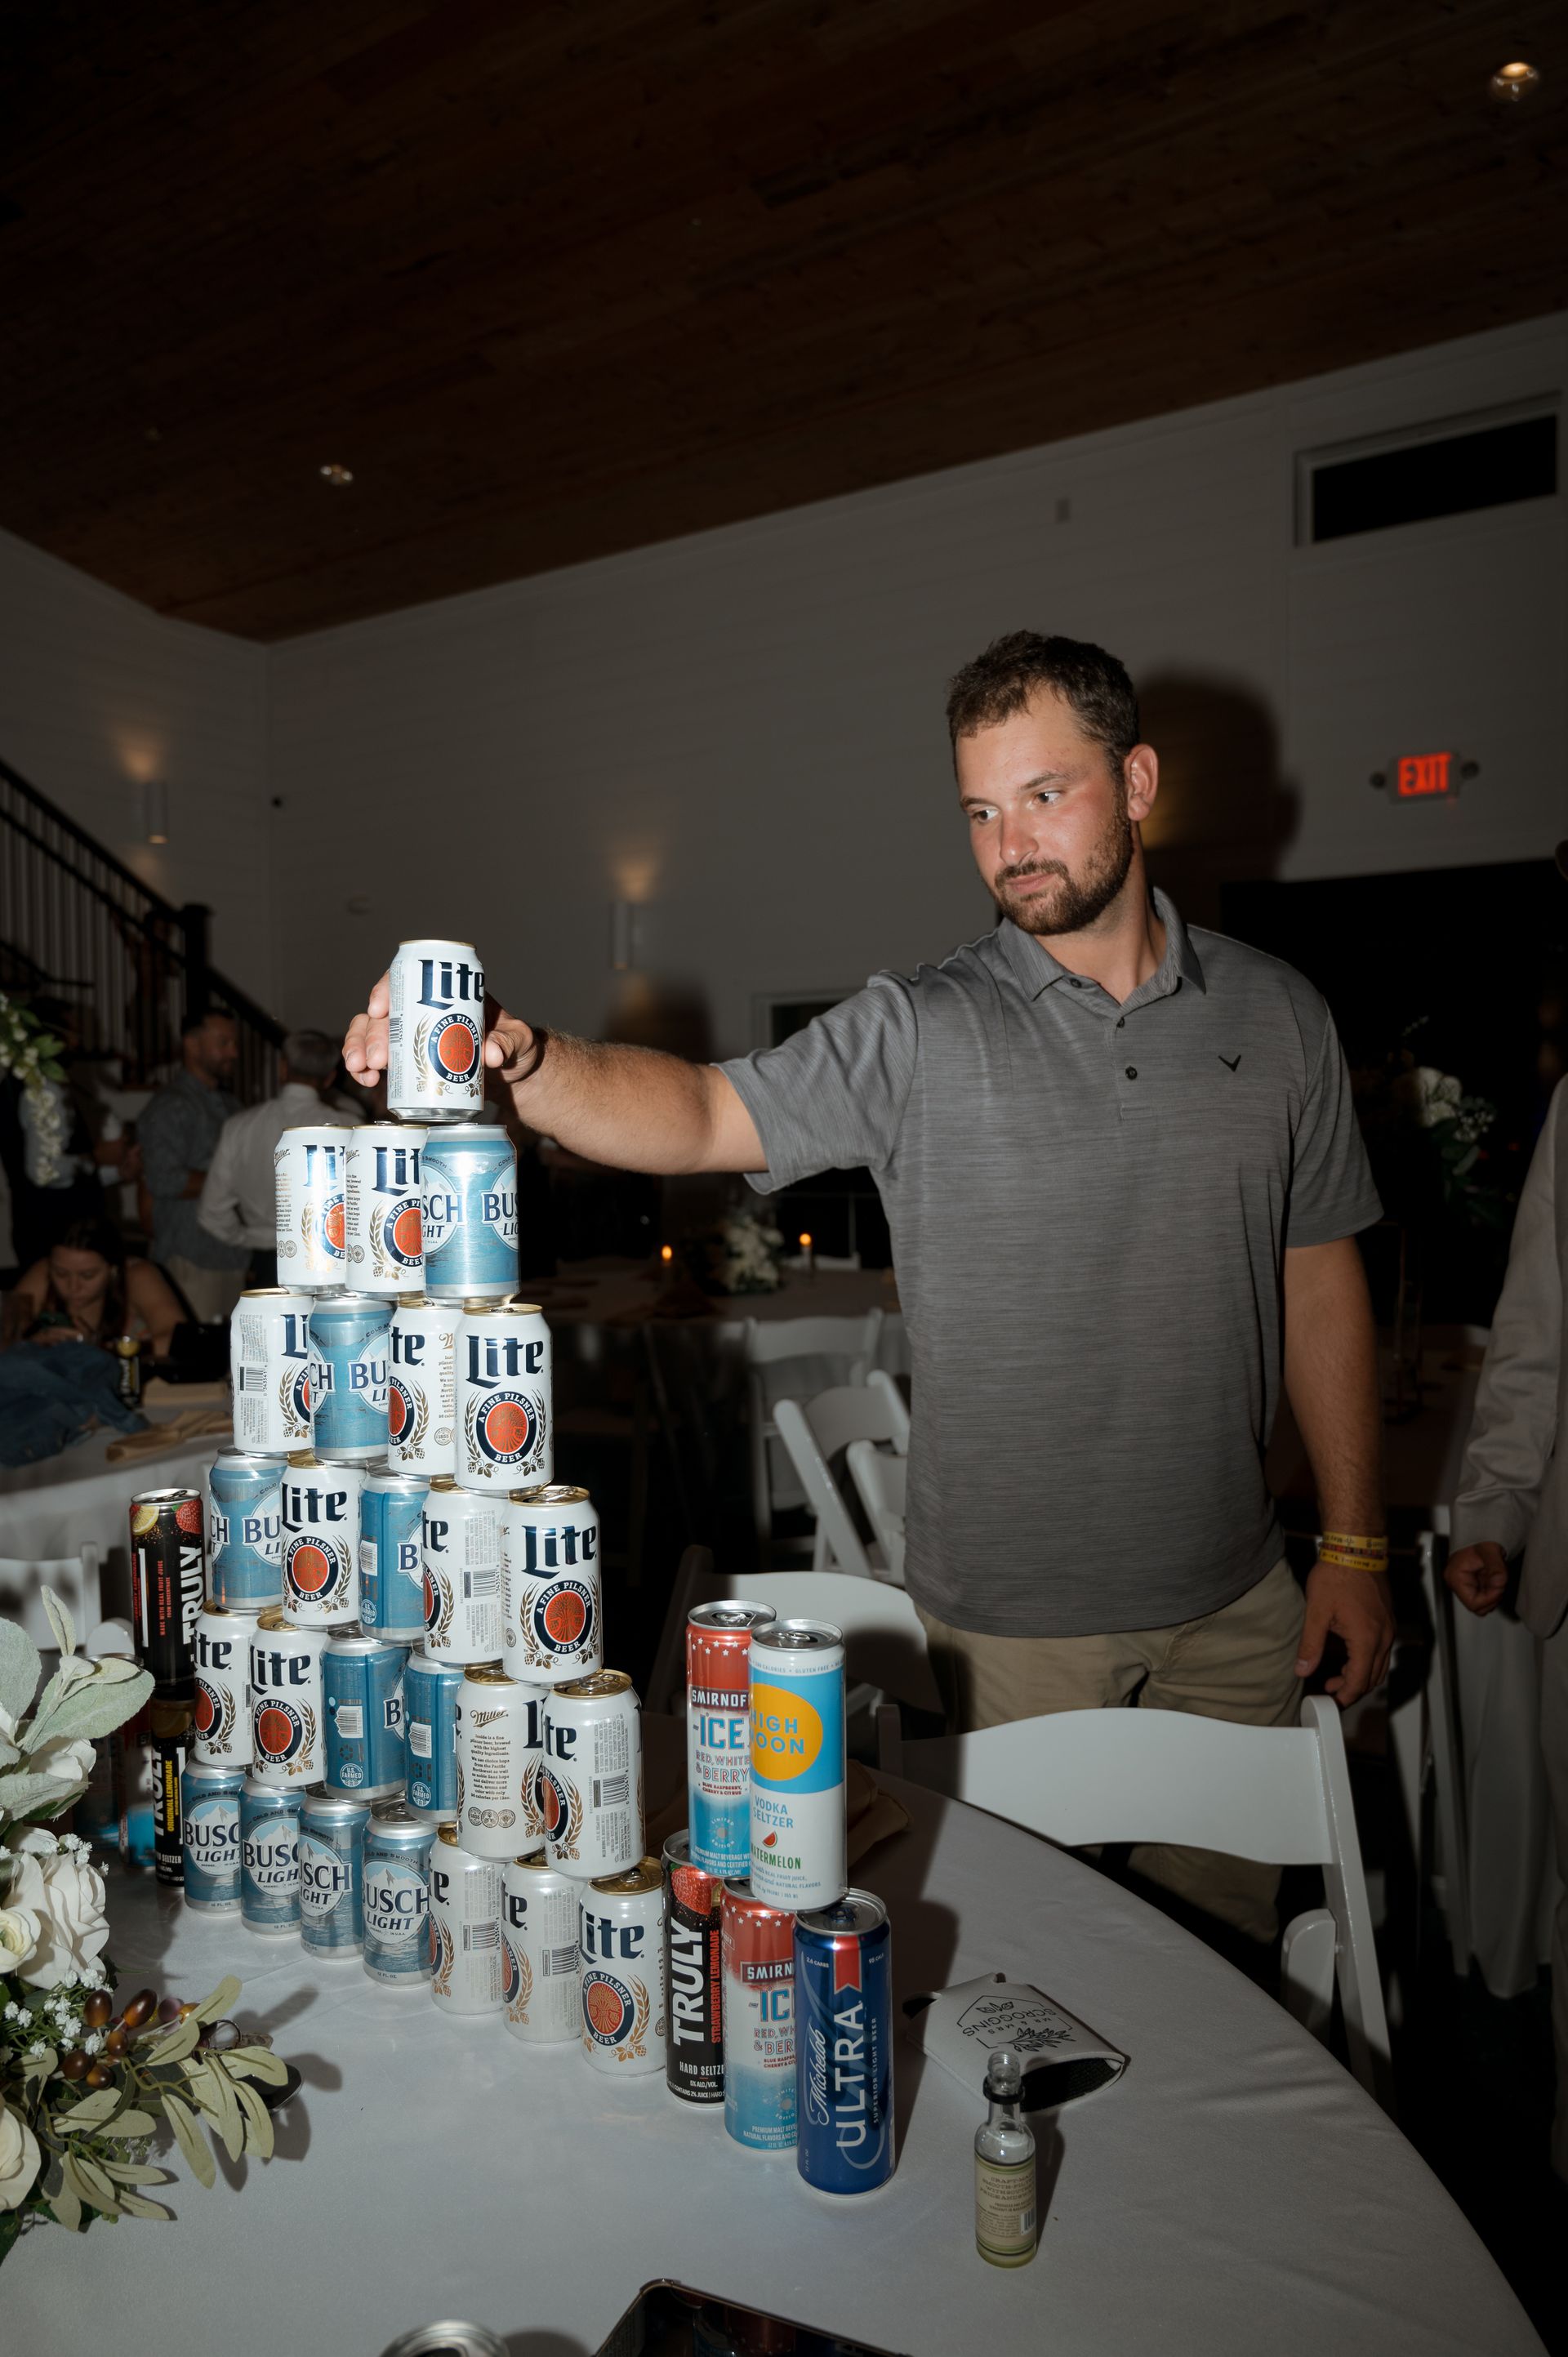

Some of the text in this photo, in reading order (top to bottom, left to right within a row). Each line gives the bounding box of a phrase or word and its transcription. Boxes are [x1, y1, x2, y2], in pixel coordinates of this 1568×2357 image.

[1398, 751, 1451, 796] EXIT
[416, 960, 484, 1010] Lite
[436, 1016, 453, 1035] FINE
[457, 1015, 480, 1046] PILSNER
[446, 1072, 470, 1082] BEER
[302, 1145, 345, 1190] Li
[372, 1147, 420, 1196] Lit
[498, 1156, 511, 1166] COLD
[390, 1202, 409, 1222] FINE
[422, 1193, 462, 1222] SCH
[483, 1192, 519, 1221] BUS
[402, 1256, 422, 1265] BEE
[280, 1313, 308, 1360] Li
[366, 1326, 382, 1337] COLD
[391, 1326, 425, 1366] te
[466, 1335, 544, 1388] Lite
[483, 1395, 501, 1414] FINE
[504, 1392, 535, 1421] PILSNER
[494, 1453, 522, 1463] BEER
[260, 1482, 277, 1495] COLD
[282, 1482, 347, 1533] Lite
[423, 1510, 449, 1553] te
[289, 1539, 304, 1555] FINE
[306, 1538, 336, 1564] PILSNER
[521, 1526, 596, 1580] Lite
[179, 1546, 203, 1645] TRULY
[299, 1592, 323, 1600] BEER
[541, 1584, 560, 1605] FINE
[564, 1582, 591, 1608] PILSNER
[194, 1629, 232, 1669] ite
[554, 1642, 581, 1652] BEER
[251, 1644, 311, 1695] Lite
[763, 1664, 786, 1673] CALORIES
[198, 1681, 220, 1709] PILSNER
[693, 1689, 746, 1707] SMIRNOF
[256, 1700, 301, 1727] FINE PILSNER
[470, 1710, 509, 1727] Miller
[751, 1708, 798, 1734] HIGH
[543, 1714, 577, 1761] te
[700, 1713, 745, 1749] ICE
[265, 1754, 287, 1762] BEER
[696, 1750, 713, 1766] RED,
[341, 1771, 362, 1780] FARMED
[696, 1762, 750, 1783] & BERRY
[165, 1760, 175, 1832] ORIGINAL LEMONADE
[412, 1789, 430, 1798] FARMED
[702, 1787, 719, 1795] CHERRY
[753, 1807, 794, 1829] SELTZER
[755, 1796, 788, 1815] VODKA
[185, 1821, 238, 1847] BUSC
[711, 1817, 734, 1825] LIMITED
[162, 1854, 181, 1863] SELTZER
[243, 1842, 299, 1869] BUS
[390, 1853, 418, 1865] SMOOTH
[257, 1871, 299, 1883] LIGH
[301, 1862, 350, 1891] SCH
[765, 1871, 775, 1879] REAL
[301, 1891, 332, 1905] IGHT
[363, 1883, 429, 1914] USCH
[501, 1881, 528, 1928] te
[368, 1912, 414, 1930] LIGHT
[579, 1902, 644, 1964] Lite
[747, 1963, 792, 1980] SMIRN
[814, 1959, 829, 1967] CARBS
[584, 1972, 632, 2007] FINE PILSNER
[670, 1917, 704, 2046] TRULY
[710, 1929, 721, 2044] STRAWBERRY LEMONADE
[760, 1988, 795, 2022] IC
[754, 2028, 777, 2038] RED,
[962, 2008, 1056, 2037] SCROGGINS
[988, 2024, 1014, 2034] MRS
[592, 2031, 617, 2044] BEER
[754, 2038, 794, 2056] & BER
[679, 2061, 724, 2075] HARD SELTZE
[809, 2021, 830, 2126] Michelob
[833, 2004, 866, 2148] ULTRA
[674, 2083, 690, 2096] CONTAINS
[743, 2131, 761, 2140] NATURAL
[751, 2125, 773, 2133] PREMIUM
